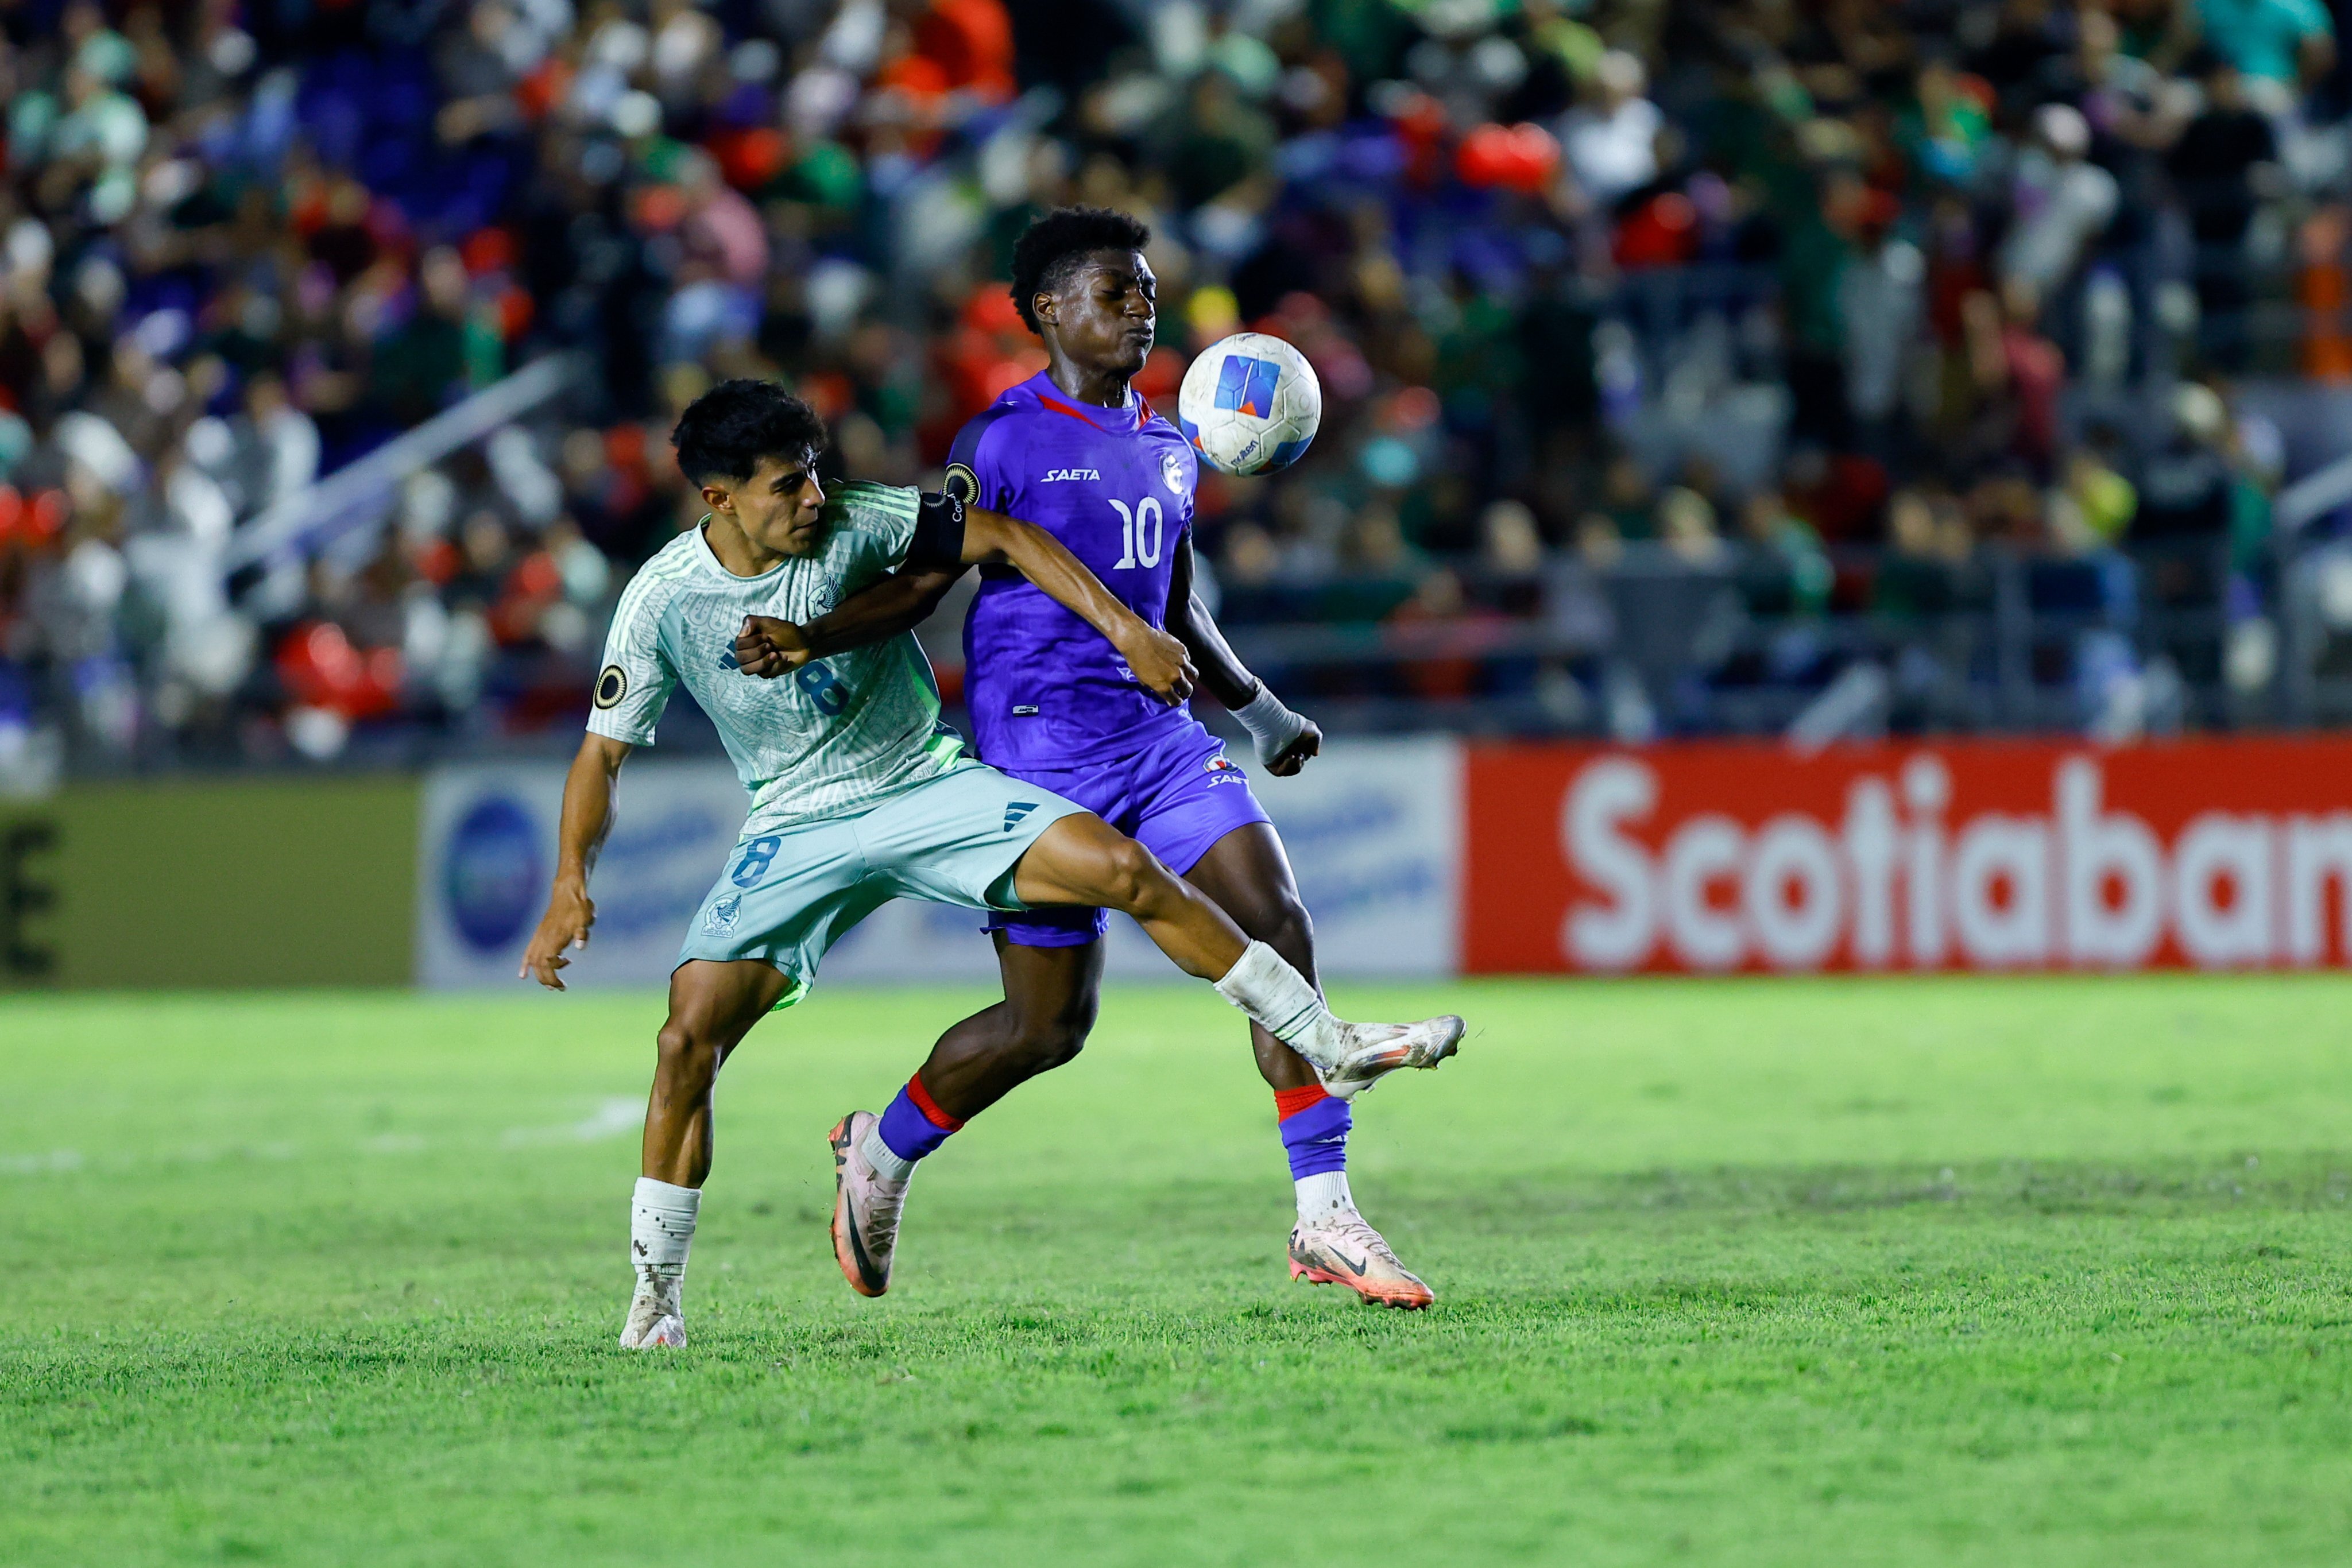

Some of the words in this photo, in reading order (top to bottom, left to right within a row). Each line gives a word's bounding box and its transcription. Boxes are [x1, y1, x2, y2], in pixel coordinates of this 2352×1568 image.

[1040, 469, 1101, 482] SAETA
[1108, 496, 1163, 569] 10
[796, 661, 849, 716] 8
[732, 835, 782, 888] 8
[703, 928, 732, 936] MEXICO
